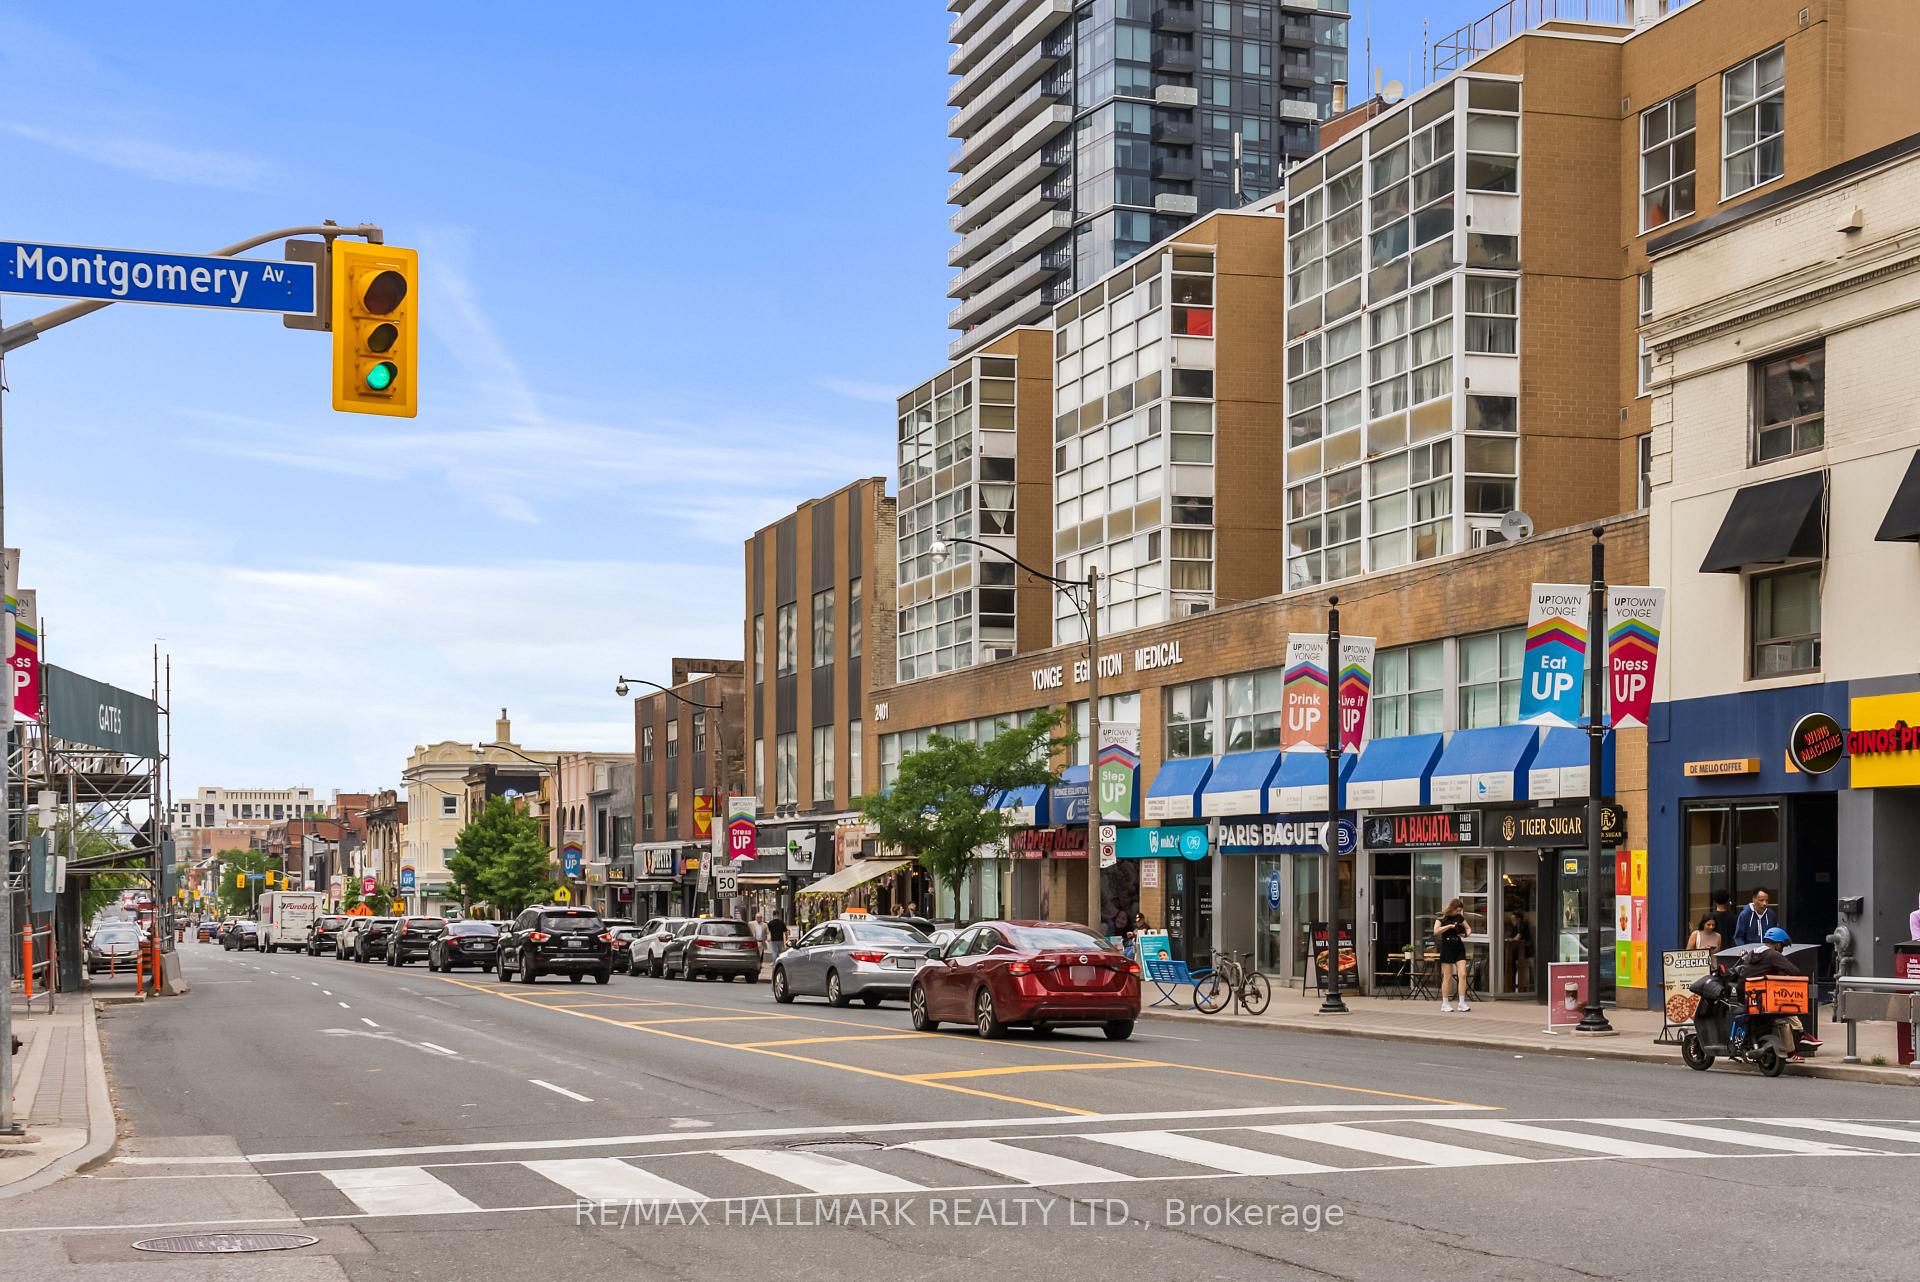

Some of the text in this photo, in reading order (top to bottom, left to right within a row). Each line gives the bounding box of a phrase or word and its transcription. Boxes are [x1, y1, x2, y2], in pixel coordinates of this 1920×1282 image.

[16, 246, 284, 303] Montgomery Av
[1538, 595, 1581, 605] UPTOWN
[1614, 597, 1657, 607] UPTOWN
[1540, 606, 1576, 616] YONGE
[1616, 608, 1652, 617] YONGE
[1293, 643, 1323, 651] UPTOWN
[1343, 645, 1371, 654] UPTOWN
[1032, 665, 1063, 691] YONGE
[1135, 640, 1183, 671] MEDICAL
[1345, 654, 1367, 663] YONGE
[1541, 655, 1567, 670] Eat
[1614, 657, 1648, 671] Dress
[1531, 672, 1574, 701] UP
[1615, 674, 1647, 703] UP
[1289, 693, 1320, 705] Drink
[1341, 695, 1364, 706] Live it
[875, 702, 888, 720] 2401
[1288, 707, 1321, 732] UP
[1343, 709, 1360, 732] UP
[1803, 725, 1830, 746] WING
[1800, 734, 1843, 762] MACHINE
[1690, 762, 1742, 773] DE MELLO COFFEE
[1102, 770, 1125, 782] Step
[1102, 783, 1126, 803] UP
[1220, 821, 1321, 846] PARIS BAGUET
[1395, 815, 1451, 843] LA BACIATA
[1520, 817, 1582, 836] TIGER SUGAR
[733, 836, 751, 850] UP
[1027, 830, 1054, 852] Drug
[565, 860, 577, 869] UP
[719, 878, 735, 889] 50
[286, 902, 318, 910] Purolator
[1774, 989, 1803, 998] MOVIN
